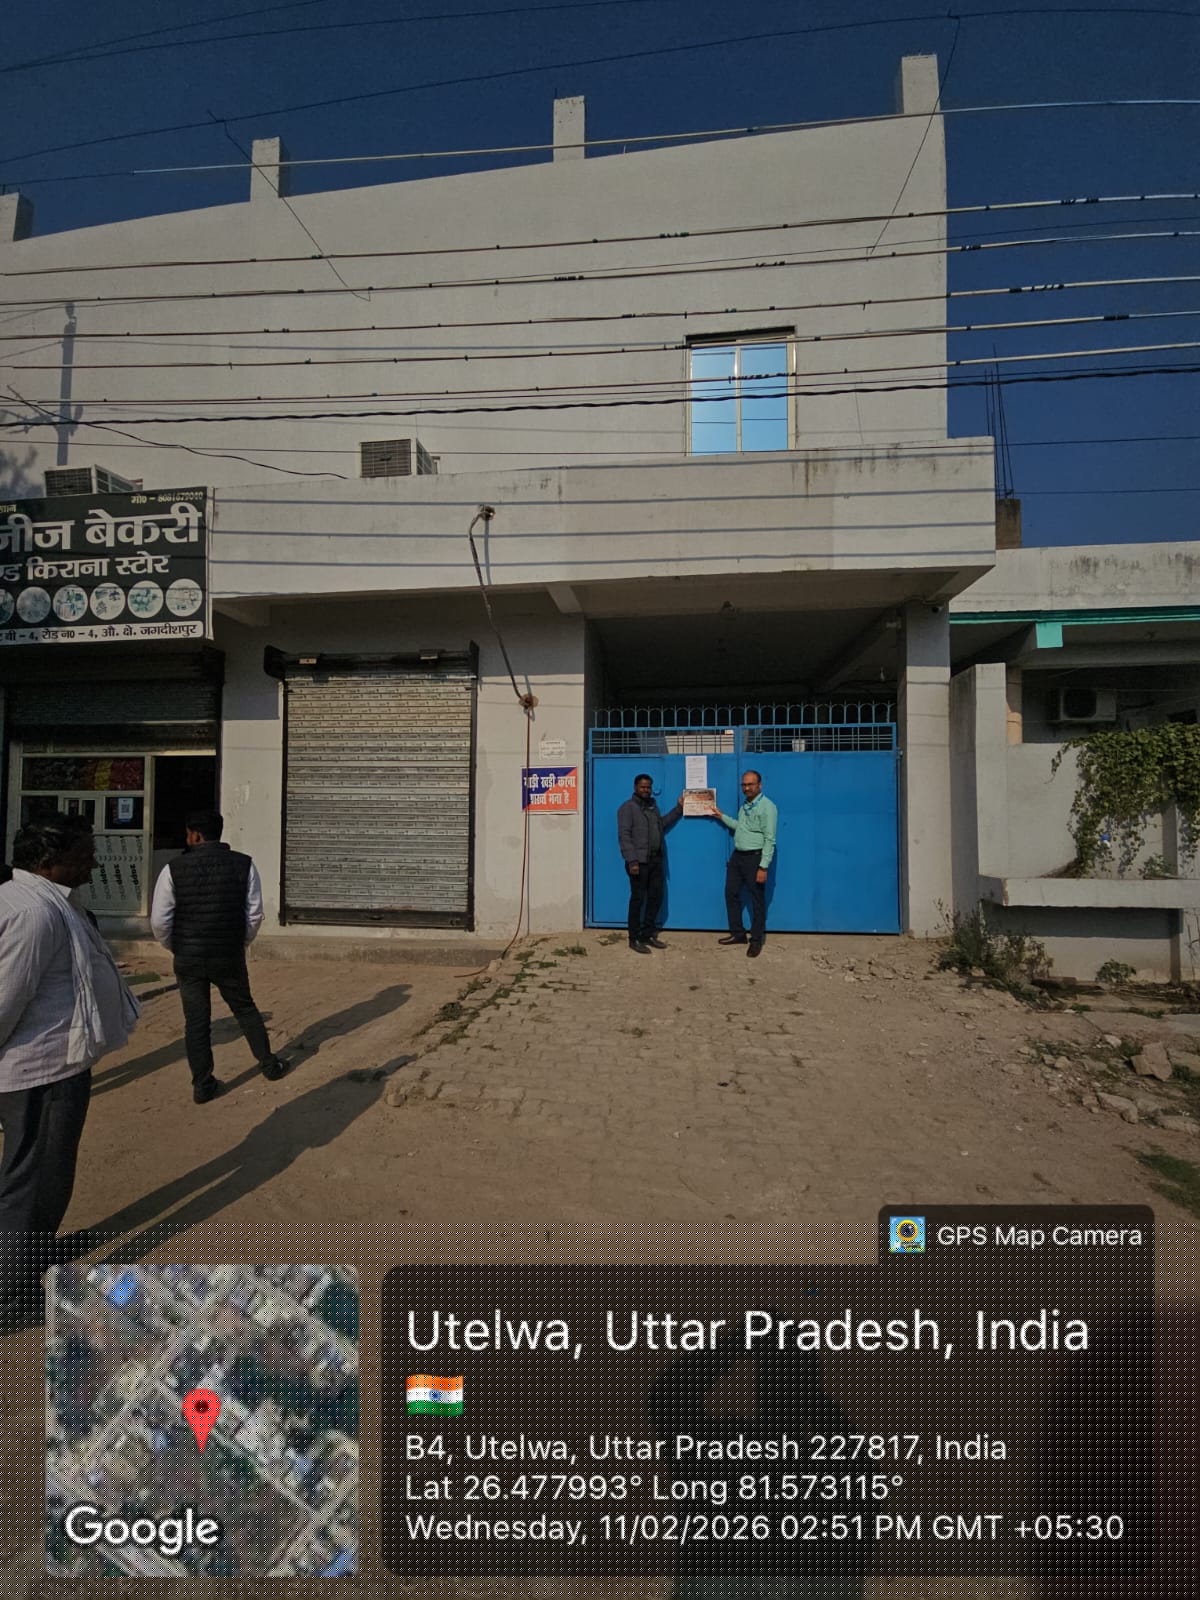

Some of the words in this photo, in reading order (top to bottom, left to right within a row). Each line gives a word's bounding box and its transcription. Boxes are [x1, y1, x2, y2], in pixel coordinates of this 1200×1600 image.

[84, 502, 203, 548] बेकरी
[27, 556, 110, 581] किराना
[115, 551, 172, 576] स्टोर
[42, 628, 59, 640] रोड
[140, 624, 197, 637] जगदीशपुर
